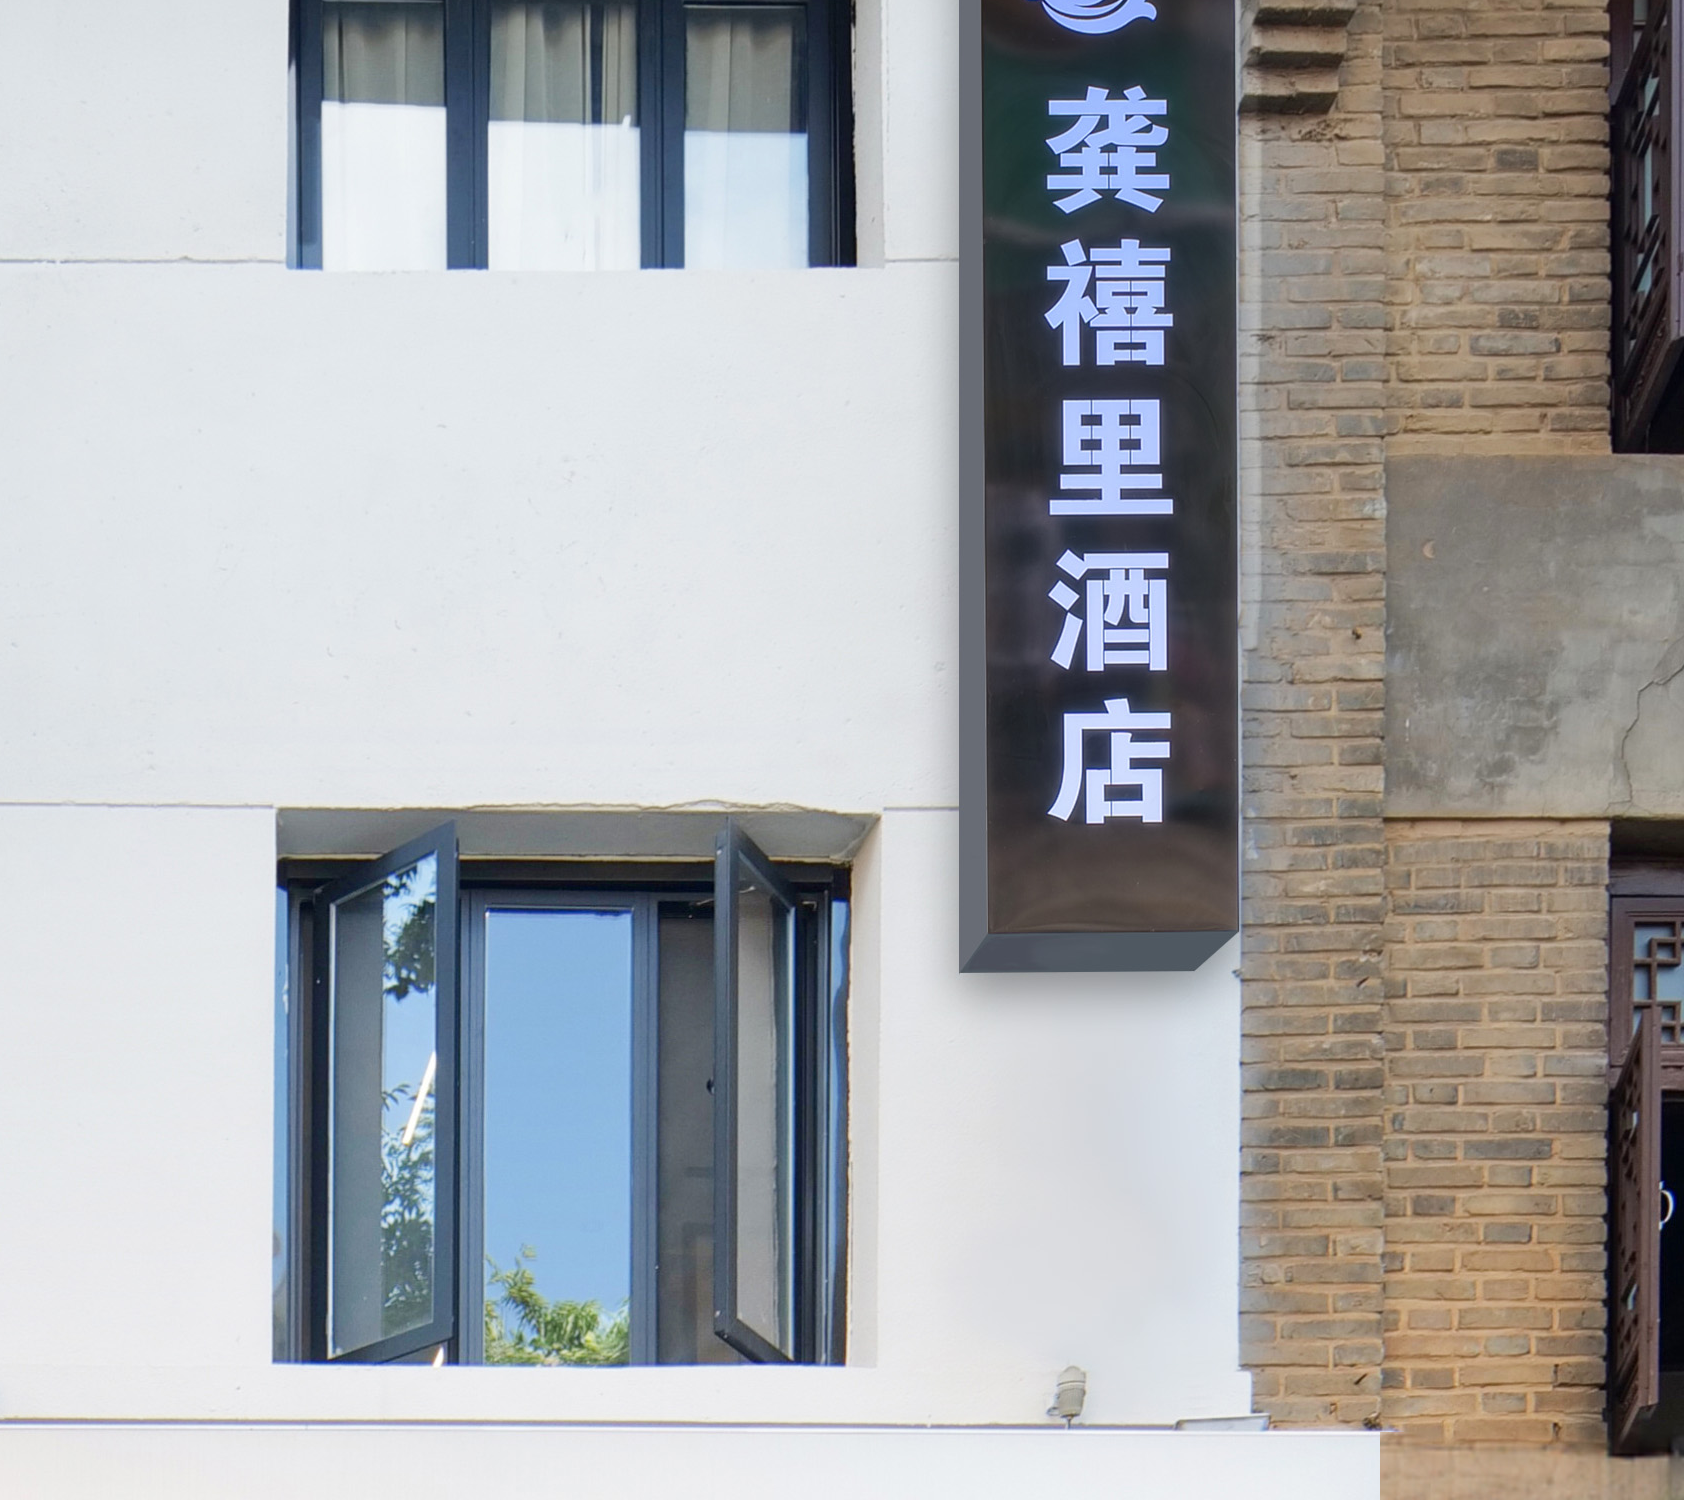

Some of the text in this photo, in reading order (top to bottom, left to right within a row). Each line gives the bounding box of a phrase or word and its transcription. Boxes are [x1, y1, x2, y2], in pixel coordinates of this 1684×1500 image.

[1044, 86, 1176, 827] 龚禧里酒店
